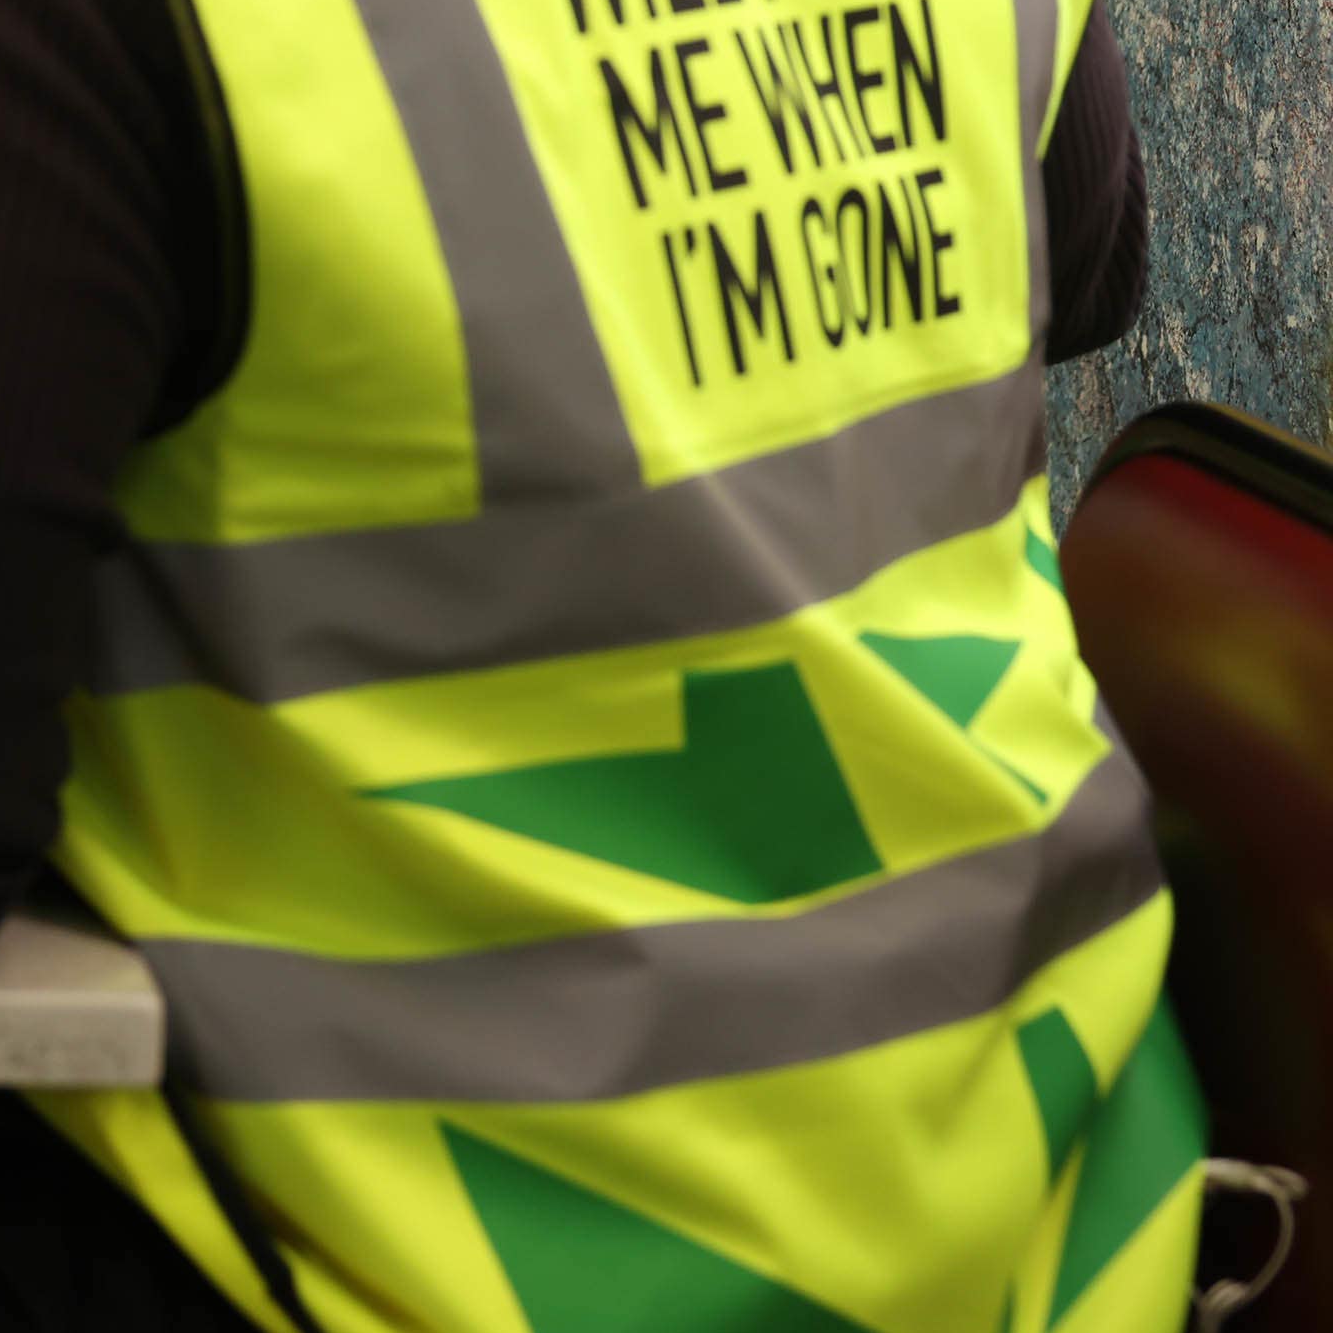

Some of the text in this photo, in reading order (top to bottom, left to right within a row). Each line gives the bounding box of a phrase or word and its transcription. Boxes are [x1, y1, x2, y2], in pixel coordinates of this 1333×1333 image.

[598, 38, 749, 210] ME
[662, 168, 963, 388] I'M GONE
